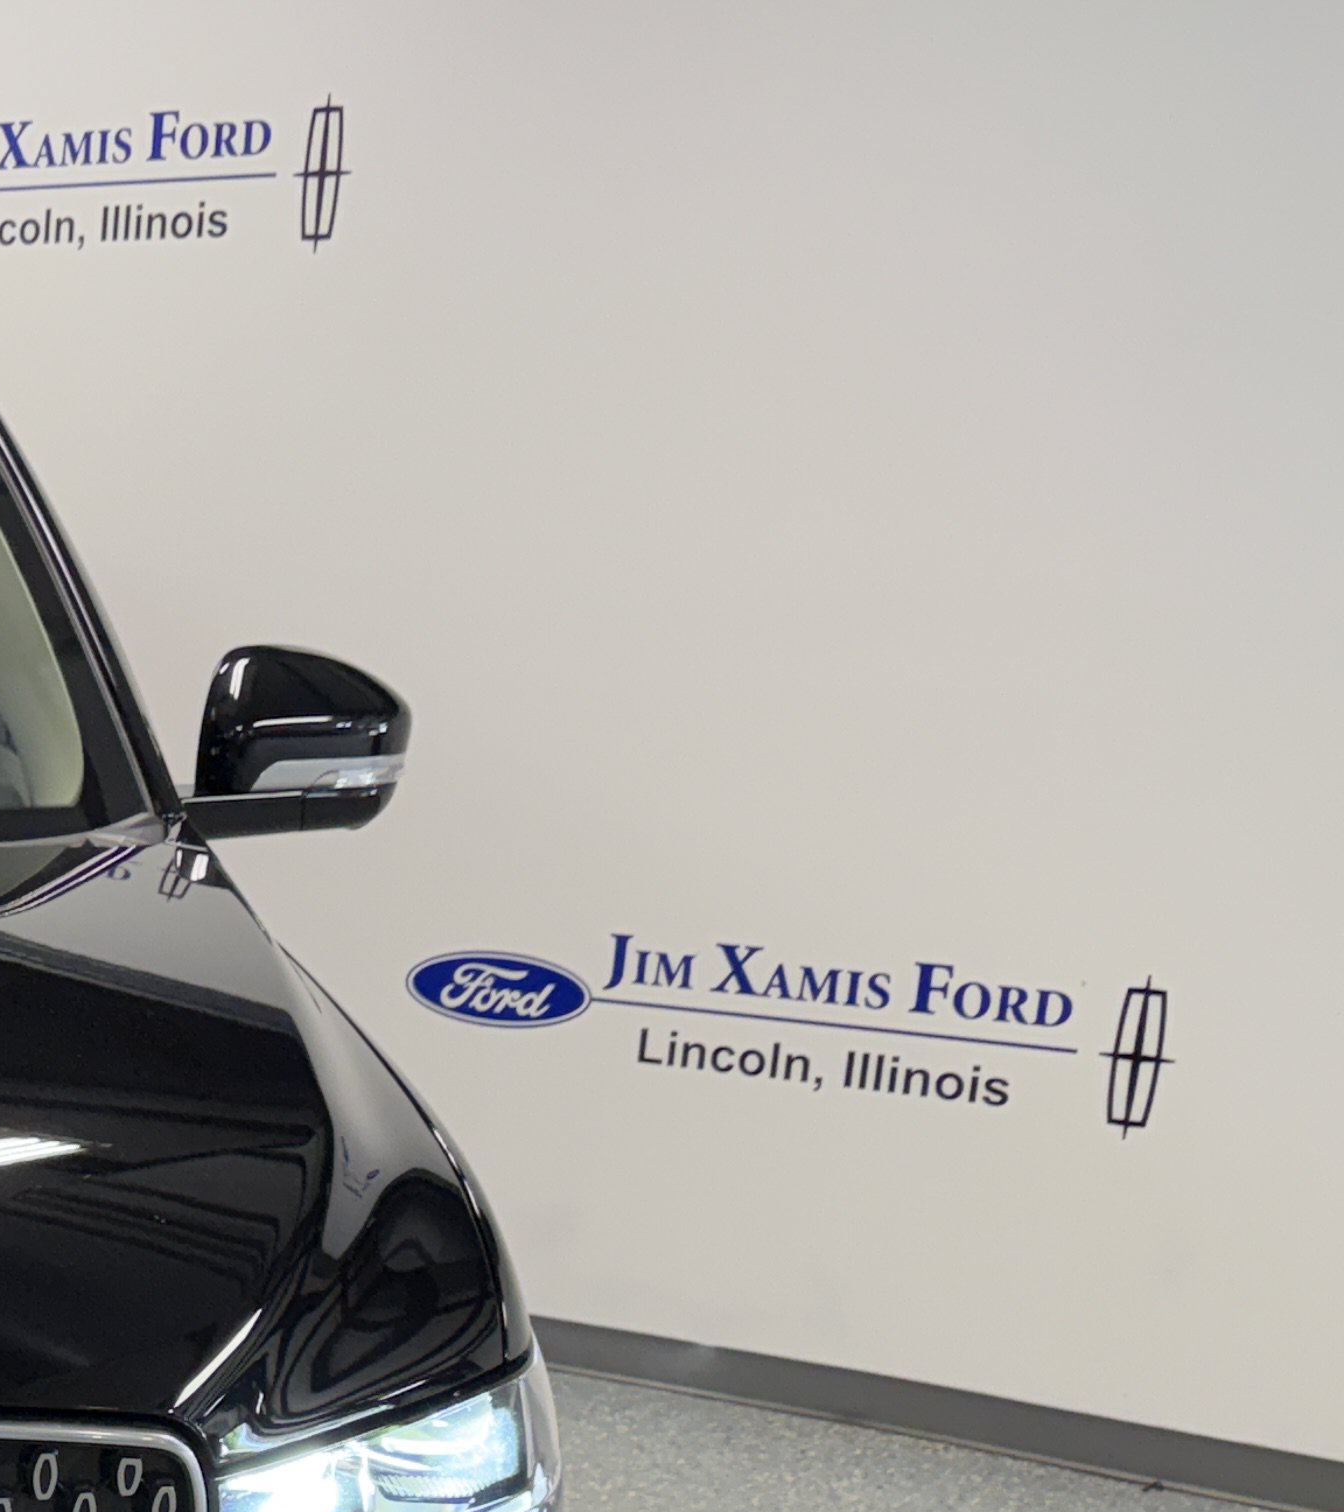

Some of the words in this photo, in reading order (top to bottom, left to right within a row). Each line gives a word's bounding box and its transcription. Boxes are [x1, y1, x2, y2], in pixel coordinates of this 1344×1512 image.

[146, 110, 272, 162] FORD
[100, 202, 229, 244] Illinois
[439, 962, 553, 1020] Ford
[601, 932, 697, 991] JIM
[710, 942, 892, 1010] XAMIS
[909, 962, 1074, 1030] FORD
[636, 1028, 825, 1092] Lincoln,
[842, 1050, 1011, 1108] Illinois
